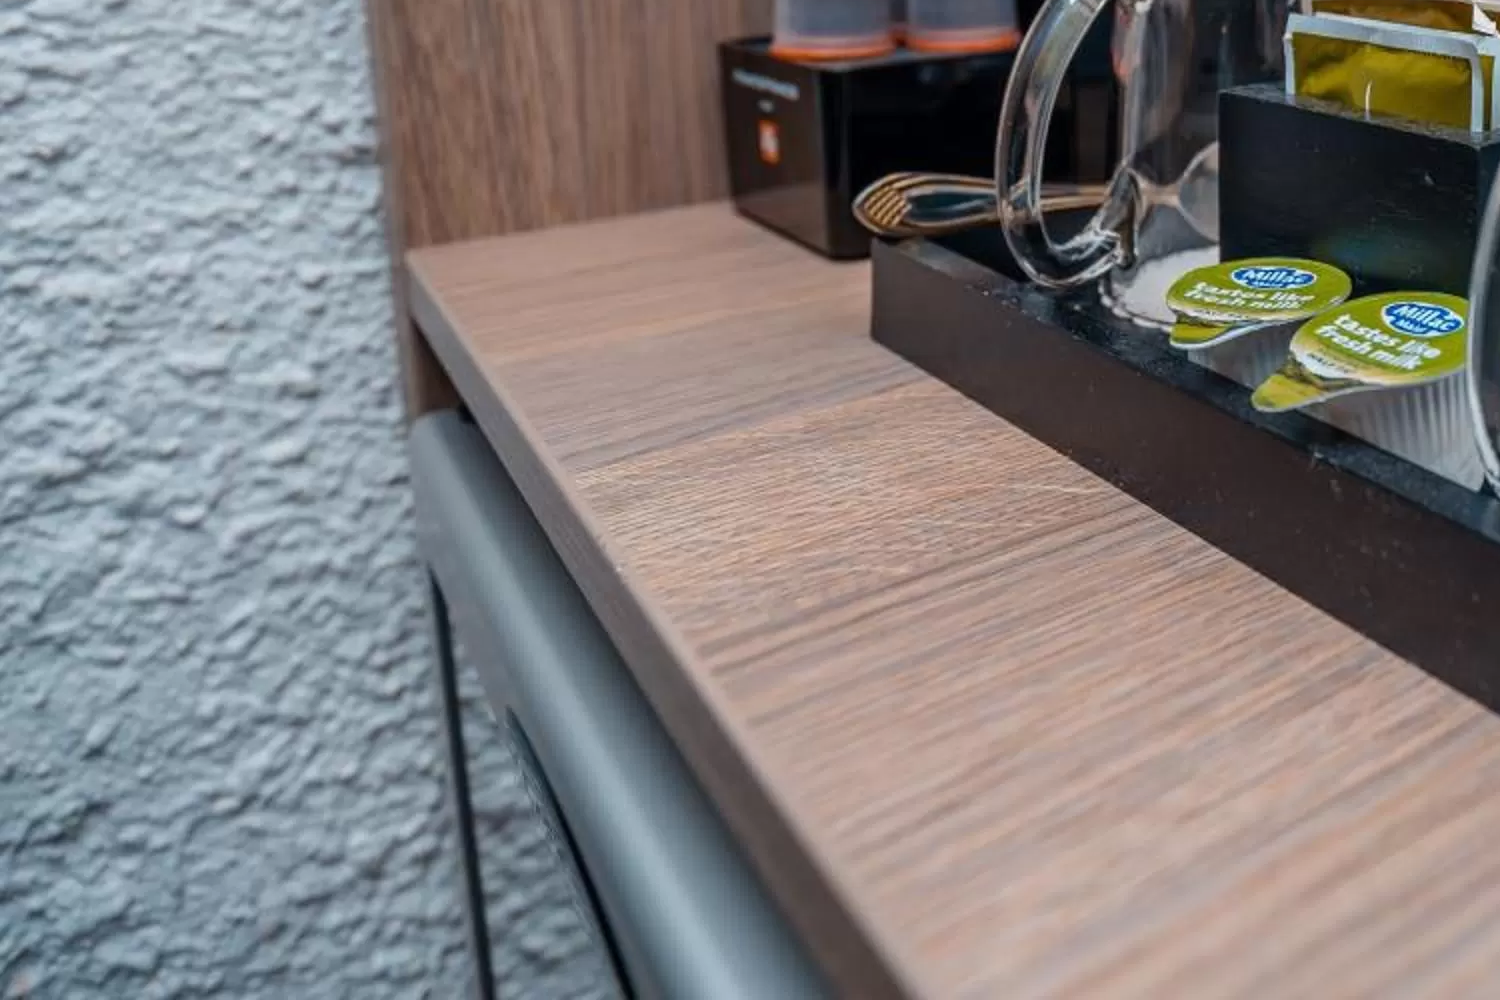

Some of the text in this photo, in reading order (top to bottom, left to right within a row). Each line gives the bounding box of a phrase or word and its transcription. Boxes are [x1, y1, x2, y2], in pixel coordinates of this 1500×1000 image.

[1334, 314, 1401, 347] tastes
[1393, 305, 1455, 331] Millac
[1315, 325, 1424, 370] fresh milk
